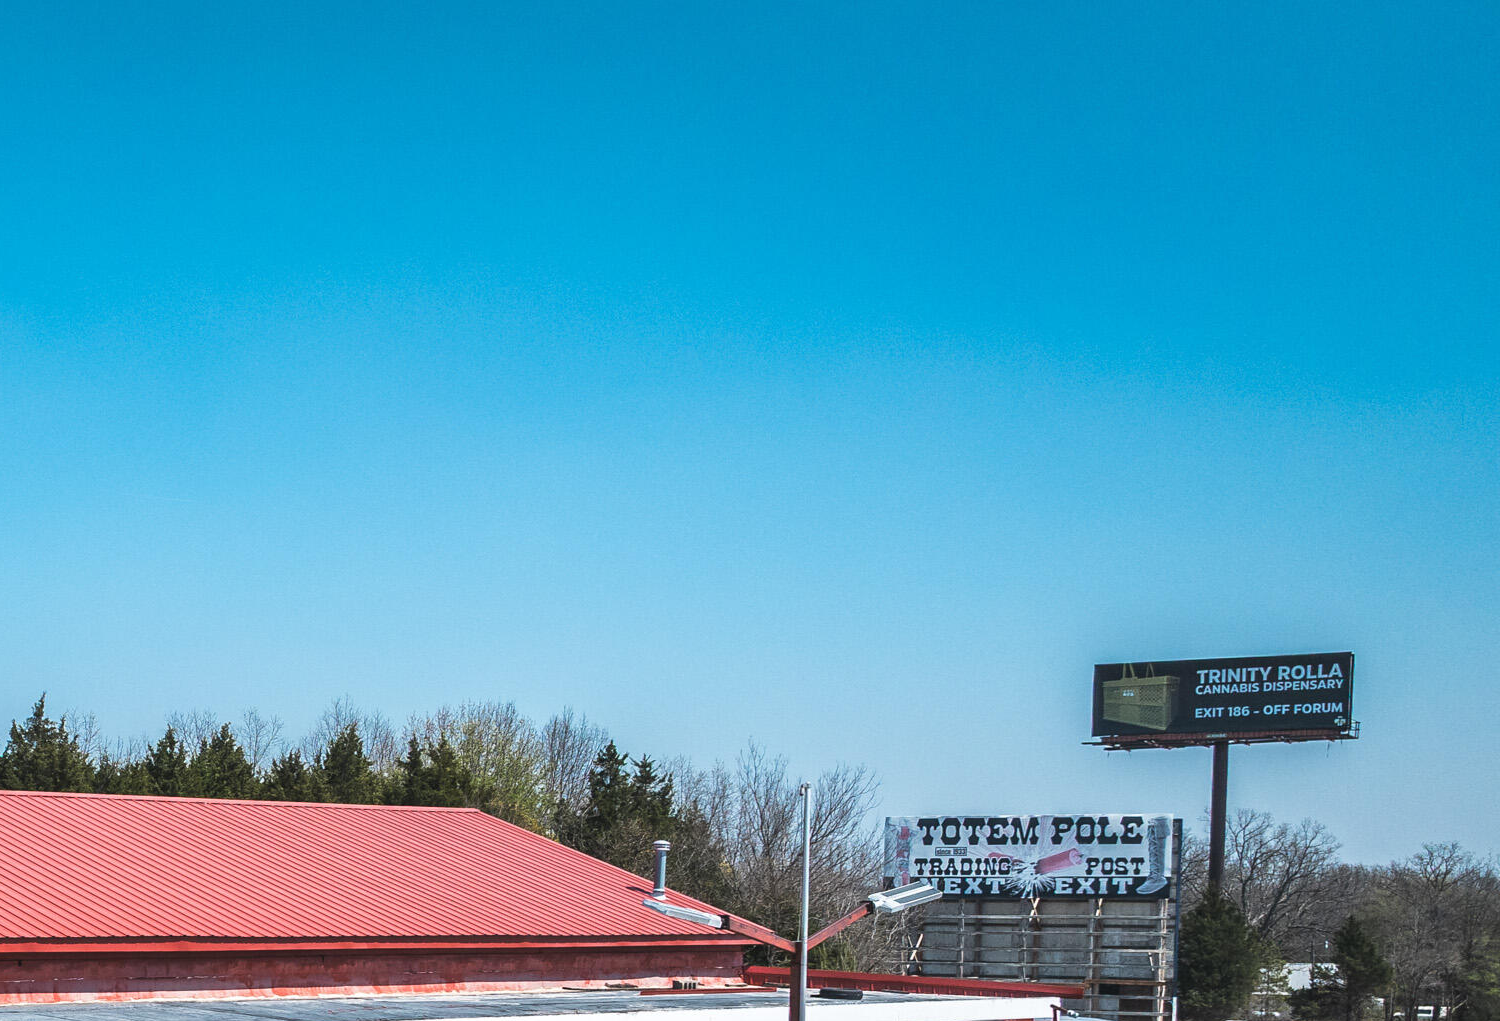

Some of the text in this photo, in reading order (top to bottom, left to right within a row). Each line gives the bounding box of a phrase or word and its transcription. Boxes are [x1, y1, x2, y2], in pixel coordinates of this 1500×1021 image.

[1196, 663, 1343, 684] TRINITY ROLLA
[1195, 679, 1344, 695] CANNABIS DISPENSARY
[1195, 706, 1225, 718] EXIT
[1227, 706, 1250, 717] 186
[1263, 704, 1291, 716] OFF
[1294, 702, 1343, 714] FORUM
[916, 816, 1144, 845] TOTEM POLE
[914, 857, 1145, 876] TRADING POST
[1054, 877, 1133, 895] EXIT
